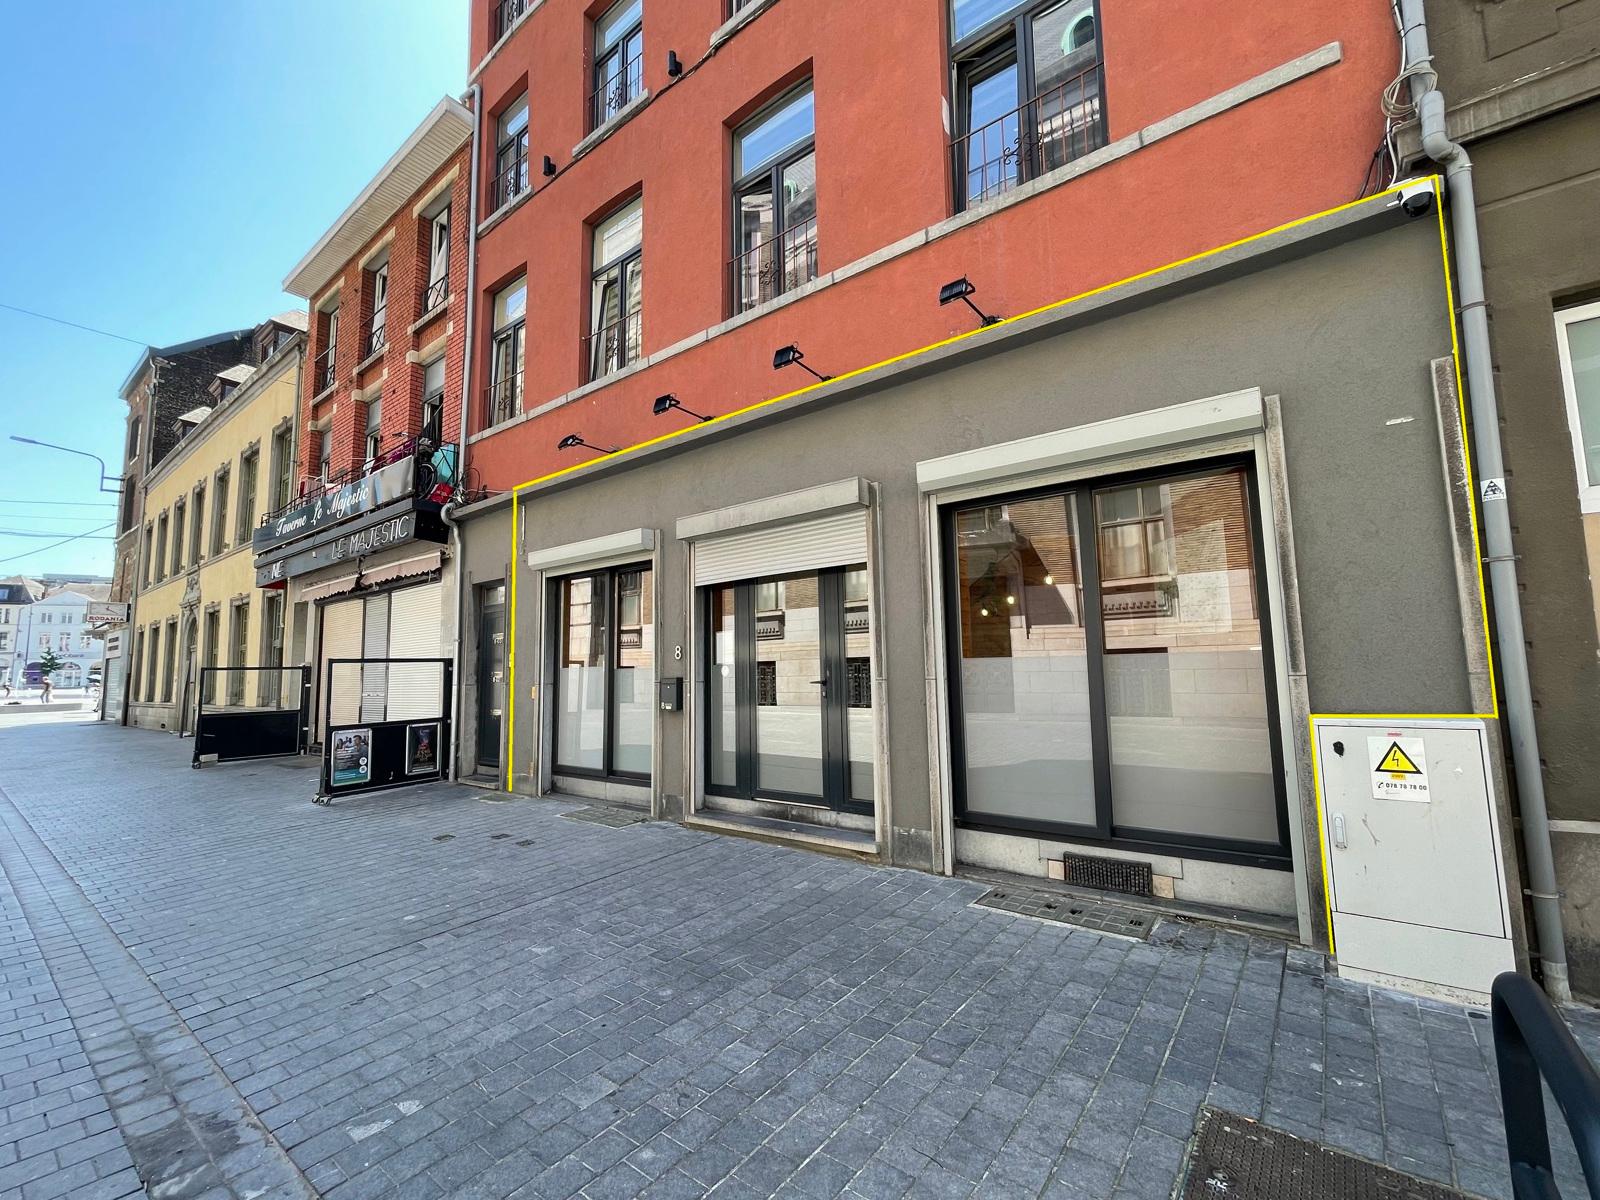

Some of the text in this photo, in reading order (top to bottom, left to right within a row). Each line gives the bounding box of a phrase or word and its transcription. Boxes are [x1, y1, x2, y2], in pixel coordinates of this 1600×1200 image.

[275, 485, 369, 536] Taverne Le Majestic
[331, 537, 346, 559] LE
[349, 515, 409, 555] MAJESTIC
[675, 645, 682, 660] 8
